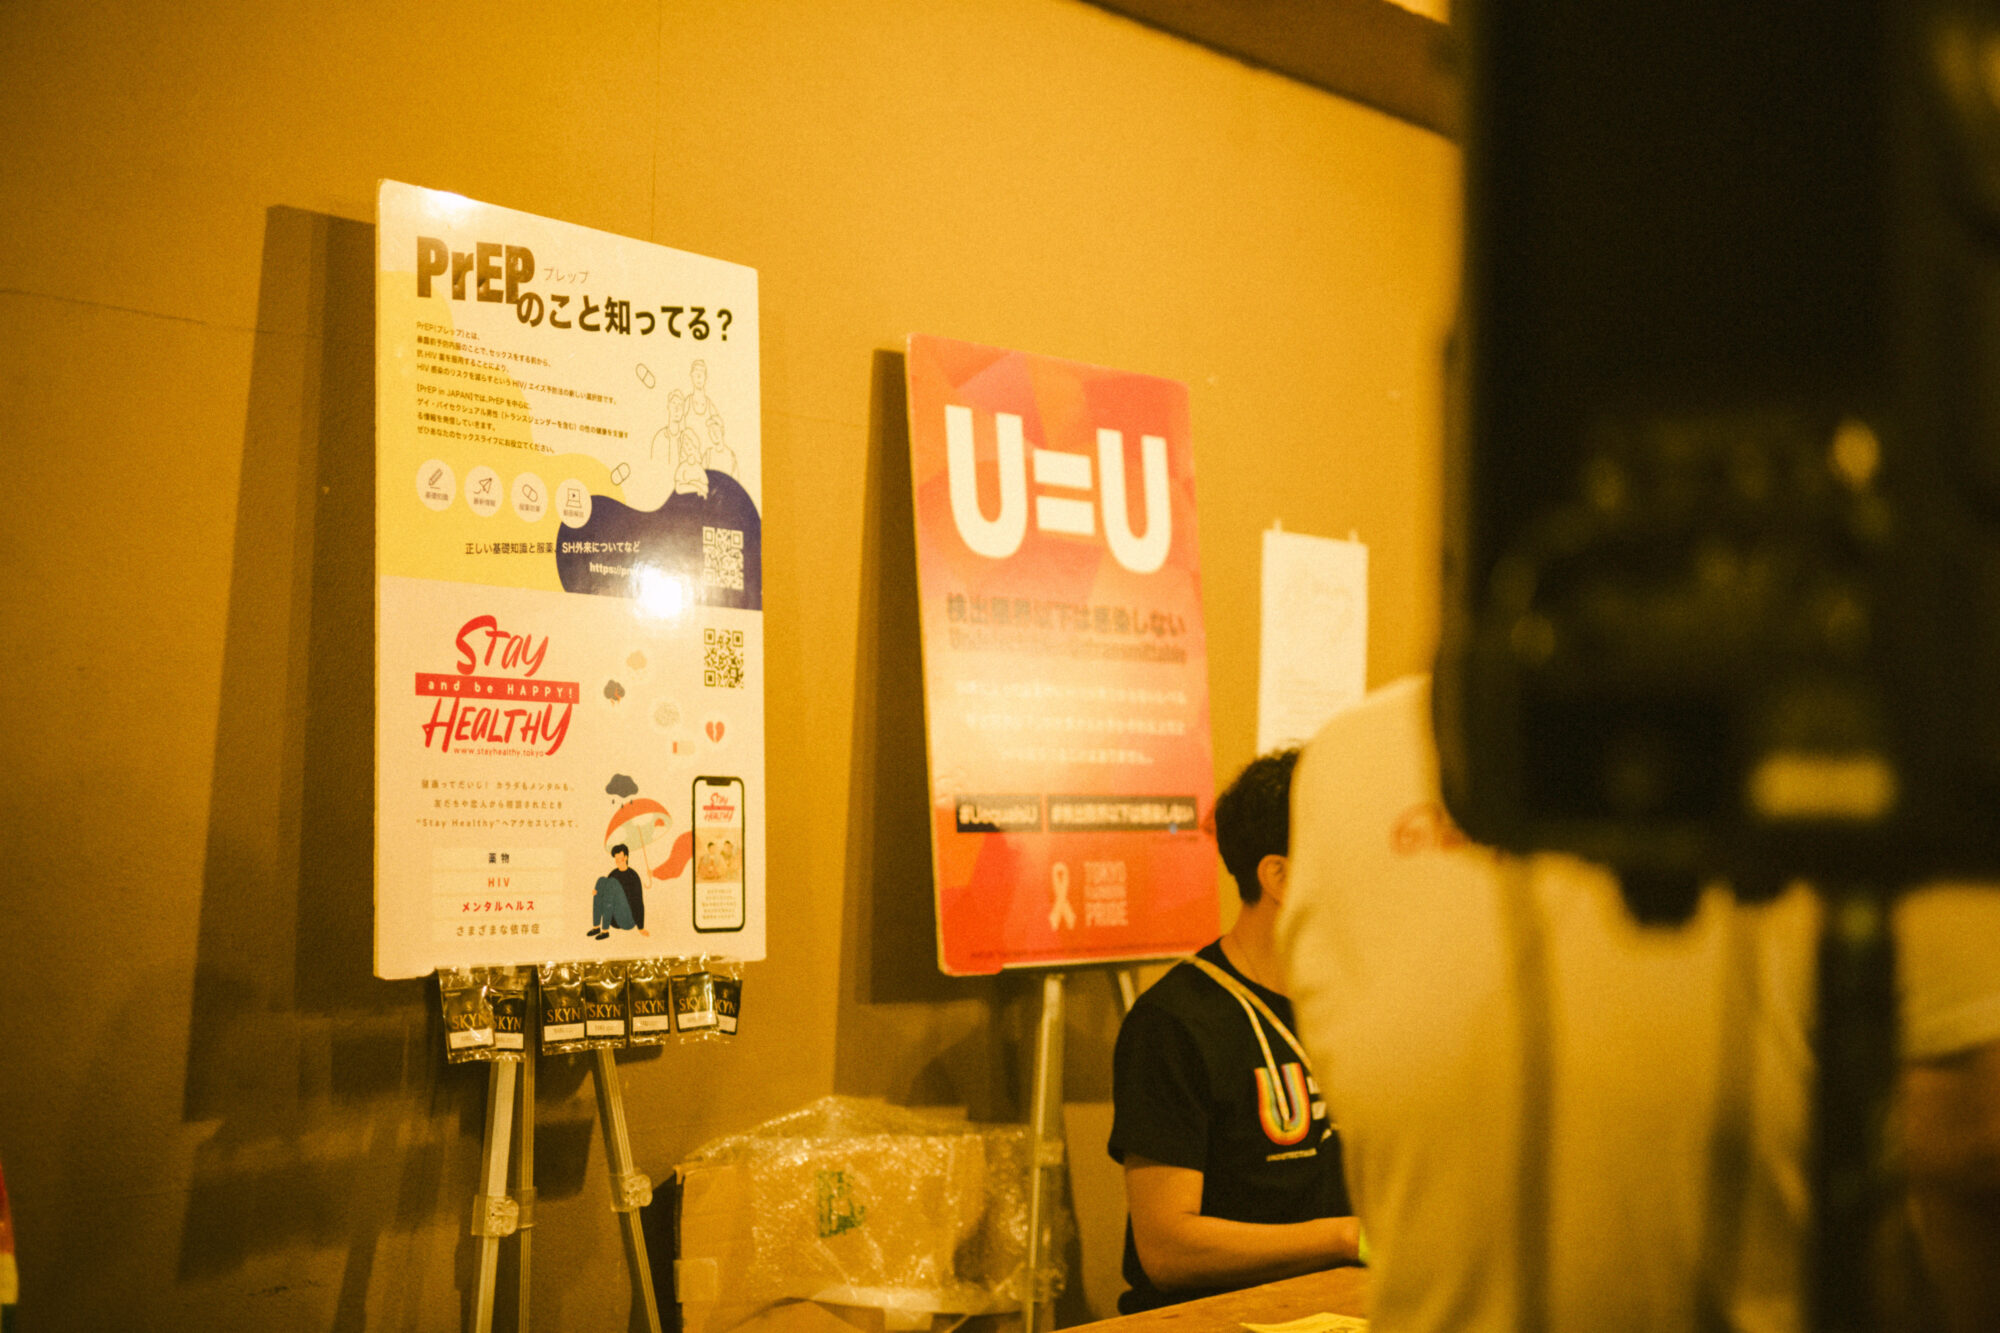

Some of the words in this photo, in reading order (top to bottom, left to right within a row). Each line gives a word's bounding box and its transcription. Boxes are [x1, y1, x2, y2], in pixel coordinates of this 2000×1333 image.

[416, 235, 536, 304] PrEP
[543, 267, 590, 285] プレップ
[516, 291, 733, 342] のこと知ってる？
[944, 404, 1172, 574] U=U
[428, 680, 461, 692] and
[474, 681, 494, 694] be
[507, 683, 574, 699] HAPPY!
[488, 877, 511, 889] HIV
[462, 900, 536, 913] メンタルヘルス
[456, 922, 541, 938] さまざまな依存症
[588, 1004, 621, 1018] SKYN
[634, 1000, 665, 1014] SKYN
[547, 1008, 581, 1023] SKYN
